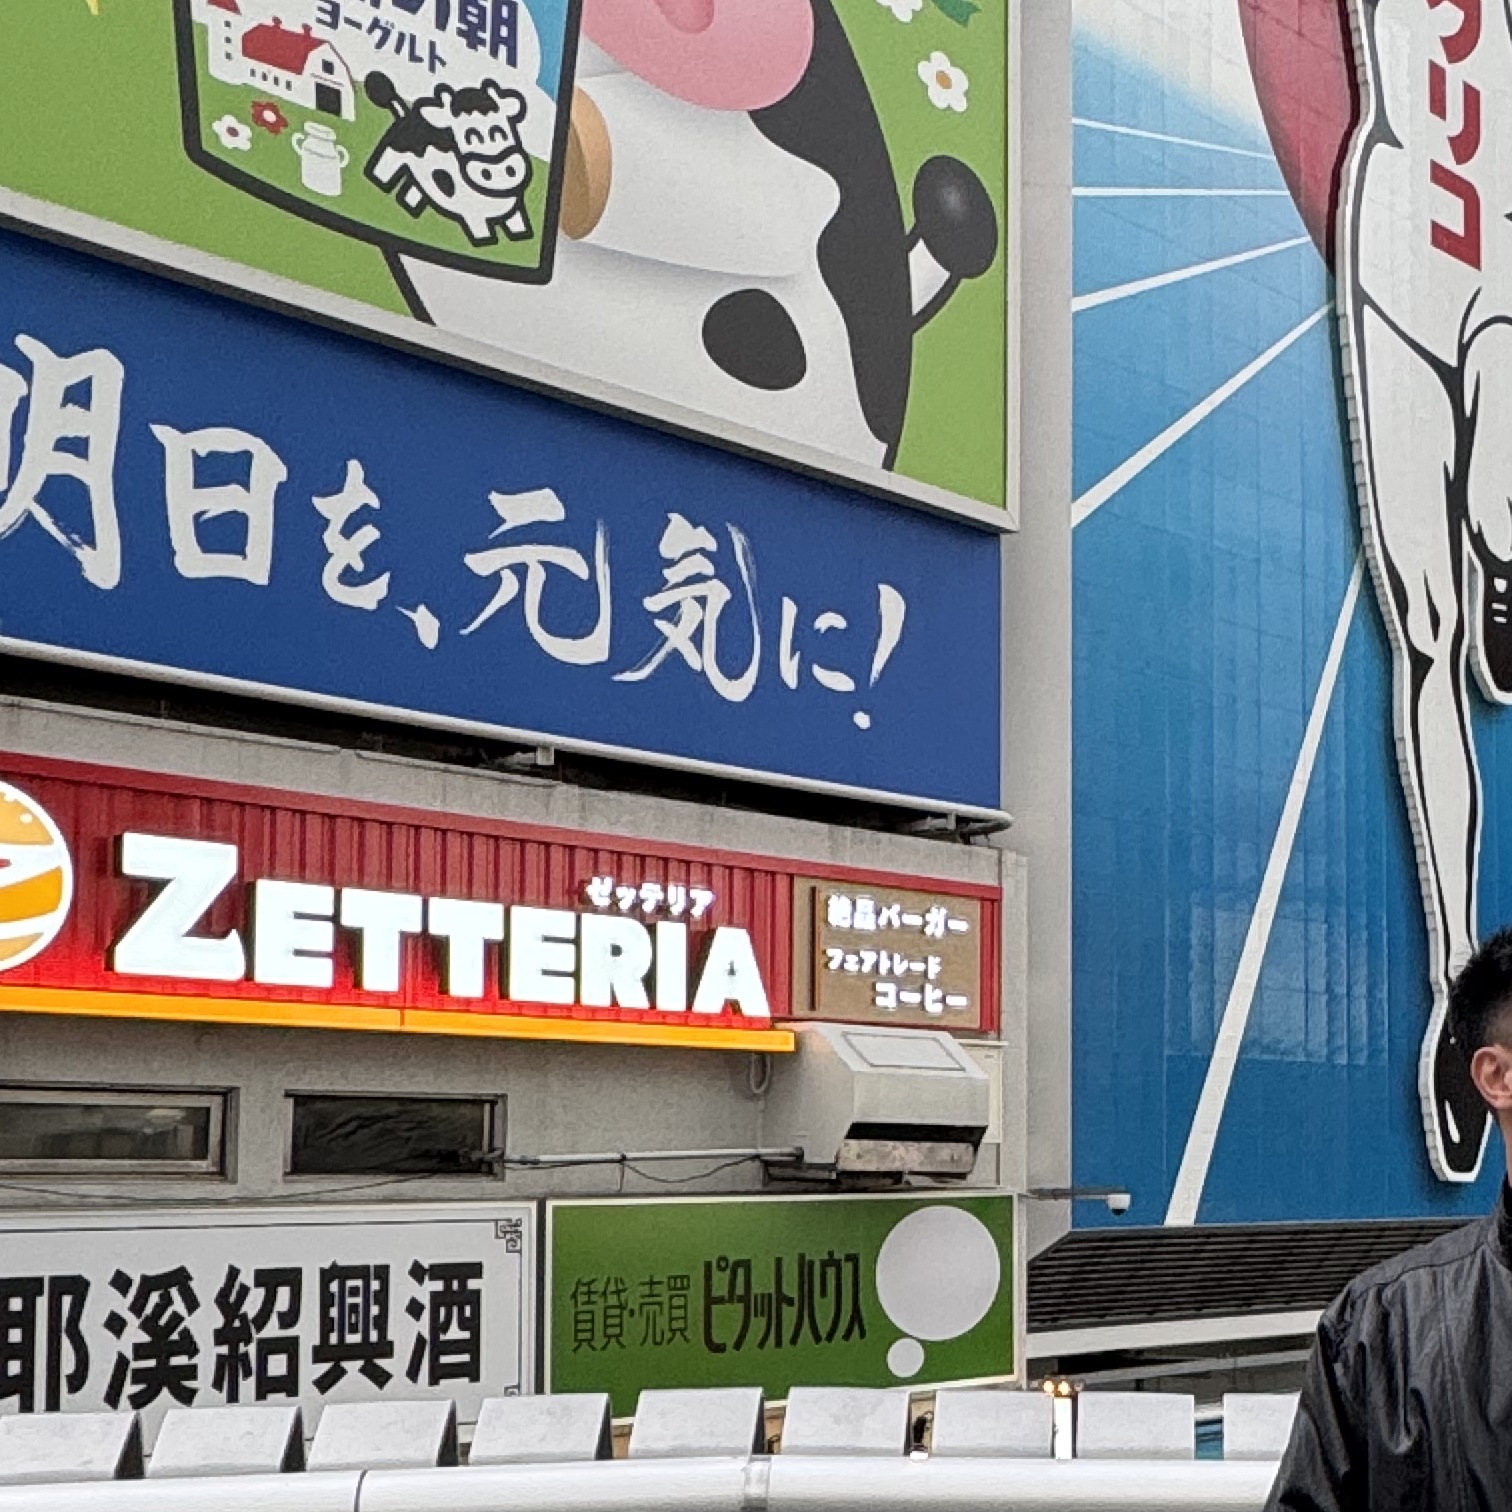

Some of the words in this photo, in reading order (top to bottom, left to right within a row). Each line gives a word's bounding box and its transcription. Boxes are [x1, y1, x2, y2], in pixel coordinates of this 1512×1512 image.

[585, 875, 716, 919] ゼッテリア
[826, 893, 970, 939] 絶品バーガー
[113, 831, 772, 1017] ZETTERIA
[825, 948, 943, 981] フェアトレード
[873, 981, 970, 1013] コーヒー
[570, 1274, 693, 1354] 賃貸・売買
[703, 1250, 868, 1354] ピタットハウス
